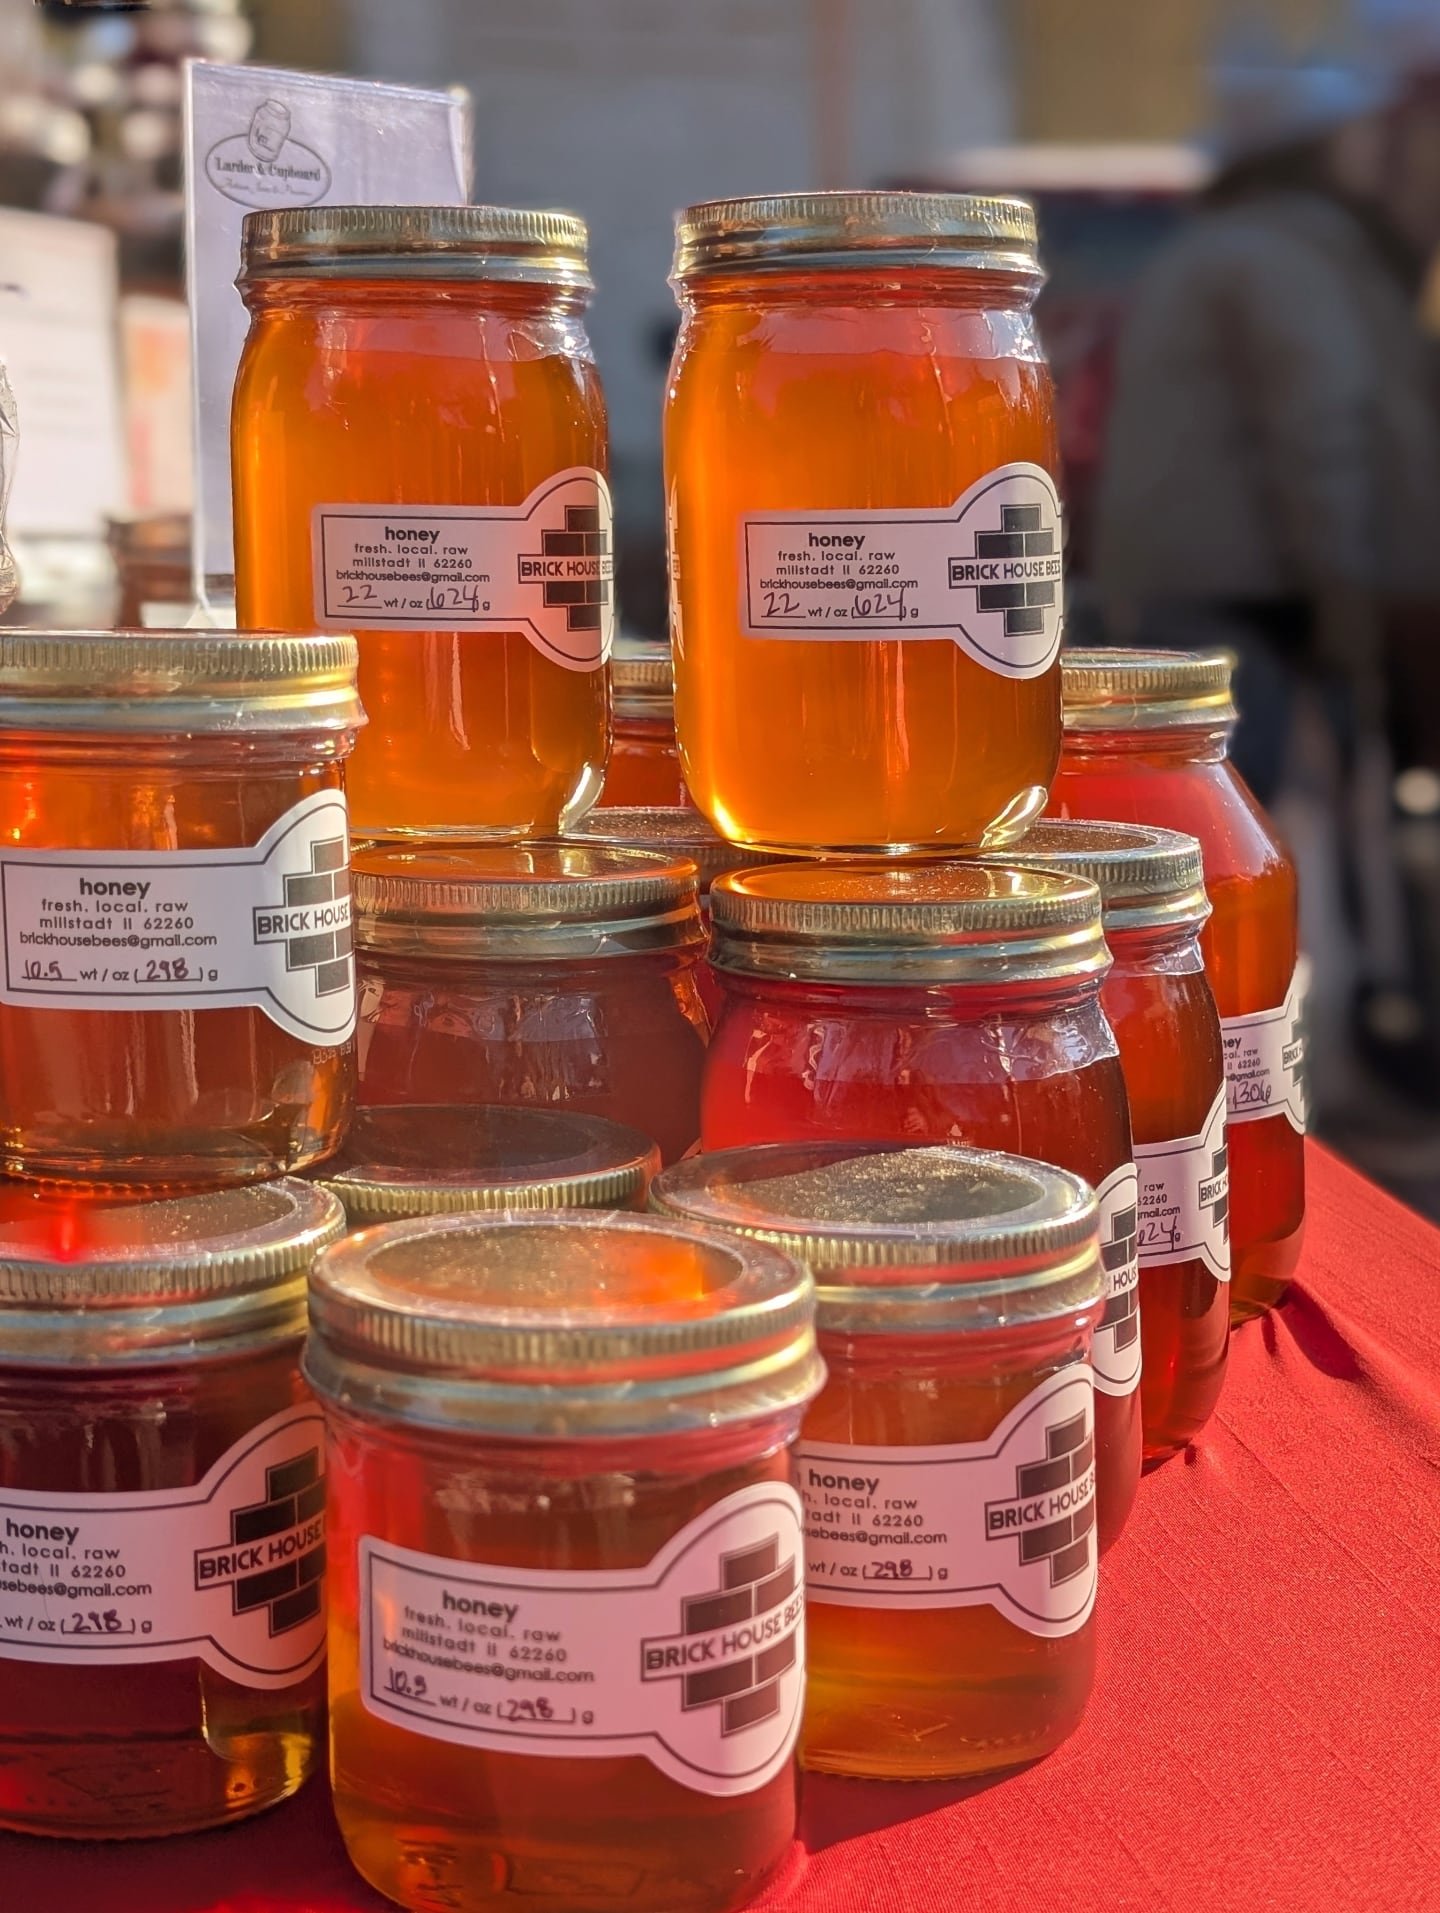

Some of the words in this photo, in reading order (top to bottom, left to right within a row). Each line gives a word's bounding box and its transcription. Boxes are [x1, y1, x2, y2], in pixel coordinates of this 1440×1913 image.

[385, 526, 440, 544] honey
[808, 532, 865, 550] honey
[354, 544, 392, 554] fresh.
[397, 544, 438, 554] local.
[778, 550, 816, 561] fresh.
[822, 551, 862, 561] local.
[869, 552, 895, 560] raw
[352, 557, 410, 568] millstadt
[434, 558, 472, 568] 62260
[521, 561, 563, 576] BRICK
[567, 561, 600, 576] HOUSE
[776, 564, 834, 575] millstadt
[859, 564, 899, 575] 62260
[952, 564, 1000, 580] BRICK
[1004, 561, 1044, 579] HOUSE
[336, 570, 490, 583] brickhousebees@gmail.com
[760, 578, 918, 591] brickhousebees@gmail.com
[342, 584, 378, 602] 22
[410, 600, 423, 608] oz
[482, 601, 490, 611] g
[763, 592, 800, 617] 22
[834, 609, 847, 617] oz
[910, 608, 918, 618] g
[79, 878, 151, 899] honey
[42, 899, 88, 912] fresh.
[96, 900, 148, 912] local.
[156, 902, 188, 912] raw
[40, 916, 112, 930] millstadt
[144, 917, 194, 930] 62260
[258, 912, 310, 935] BRICK
[314, 902, 348, 928] HOUSE
[20, 931, 217, 949] brickhousebees@gmail.com
[80, 968, 98, 980] wt
[112, 971, 129, 981] oz
[208, 970, 218, 981] g
[1244, 1049, 1258, 1057] raw
[1238, 1058, 1260, 1069] 62260
[1144, 1182, 1164, 1192] raw
[1201, 1180, 1222, 1201] BRICK
[1114, 1266, 1136, 1291] HOUS
[809, 1469, 879, 1495] honey
[824, 1493, 877, 1509] local.
[884, 1499, 918, 1509] raw
[989, 1500, 1045, 1530] BRICK
[1049, 1478, 1088, 1517] HOUSE
[872, 1514, 923, 1527] 62260
[6, 1518, 80, 1546] honey
[22, 1544, 76, 1560] local.
[84, 1549, 121, 1560] raw
[200, 1545, 263, 1579] BRICK
[268, 1519, 321, 1562] HOUSE
[71, 1564, 126, 1578] 62260
[808, 1561, 826, 1573] wt
[840, 1566, 857, 1576] oz
[938, 1568, 948, 1580] g
[442, 1590, 519, 1623] honey
[5, 1615, 23, 1629] wt
[38, 1620, 56, 1631] oz
[141, 1620, 152, 1633] g
[404, 1606, 451, 1629] fresh.
[458, 1618, 515, 1638] local.
[523, 1628, 560, 1641] raw
[402, 1626, 475, 1653] millstadt
[509, 1646, 567, 1662] 62260
[646, 1637, 716, 1670] BRICK
[722, 1610, 782, 1656] HOUSE
[383, 1637, 594, 1682] brickhousebees@gmail.com
[440, 1694, 458, 1709] wt
[474, 1702, 492, 1715] oz
[582, 1710, 594, 1724] g
